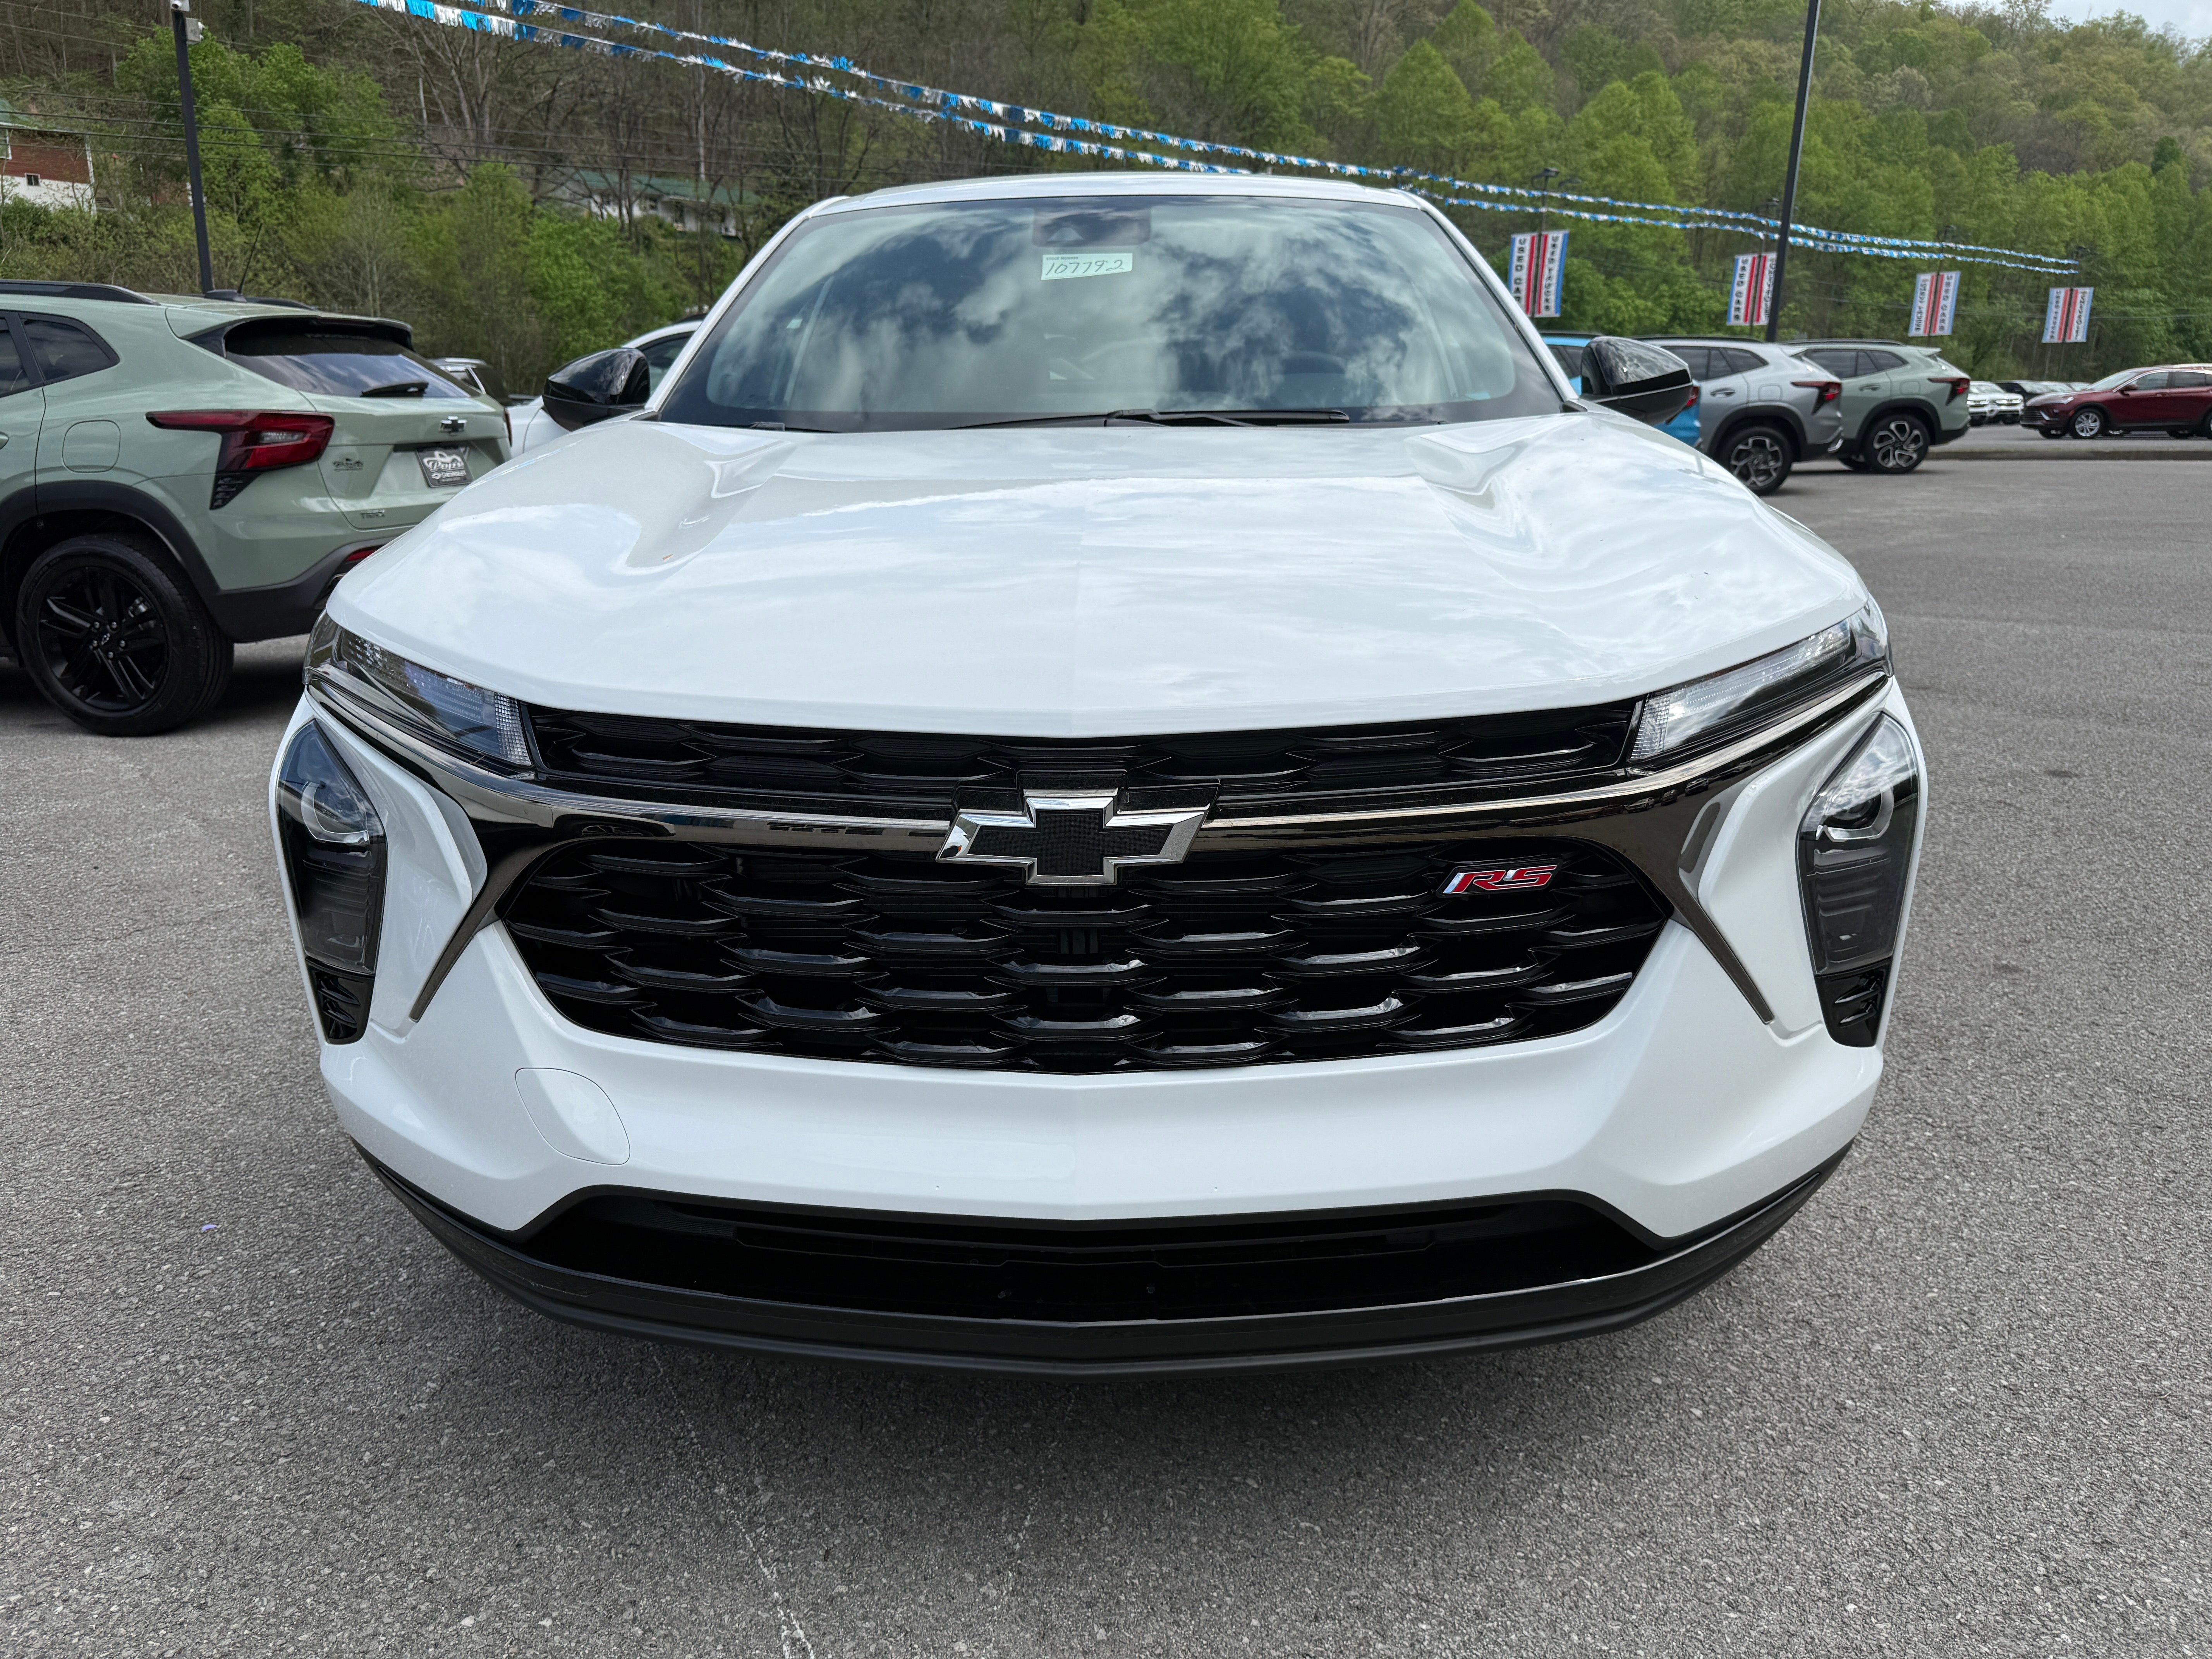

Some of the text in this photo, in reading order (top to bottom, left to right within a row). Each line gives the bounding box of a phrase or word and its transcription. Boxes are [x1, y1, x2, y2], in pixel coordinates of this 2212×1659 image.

[1046, 259, 1124, 275] 107792
[1513, 237, 1527, 304] USED CAR
[1443, 864, 1558, 894] RS
